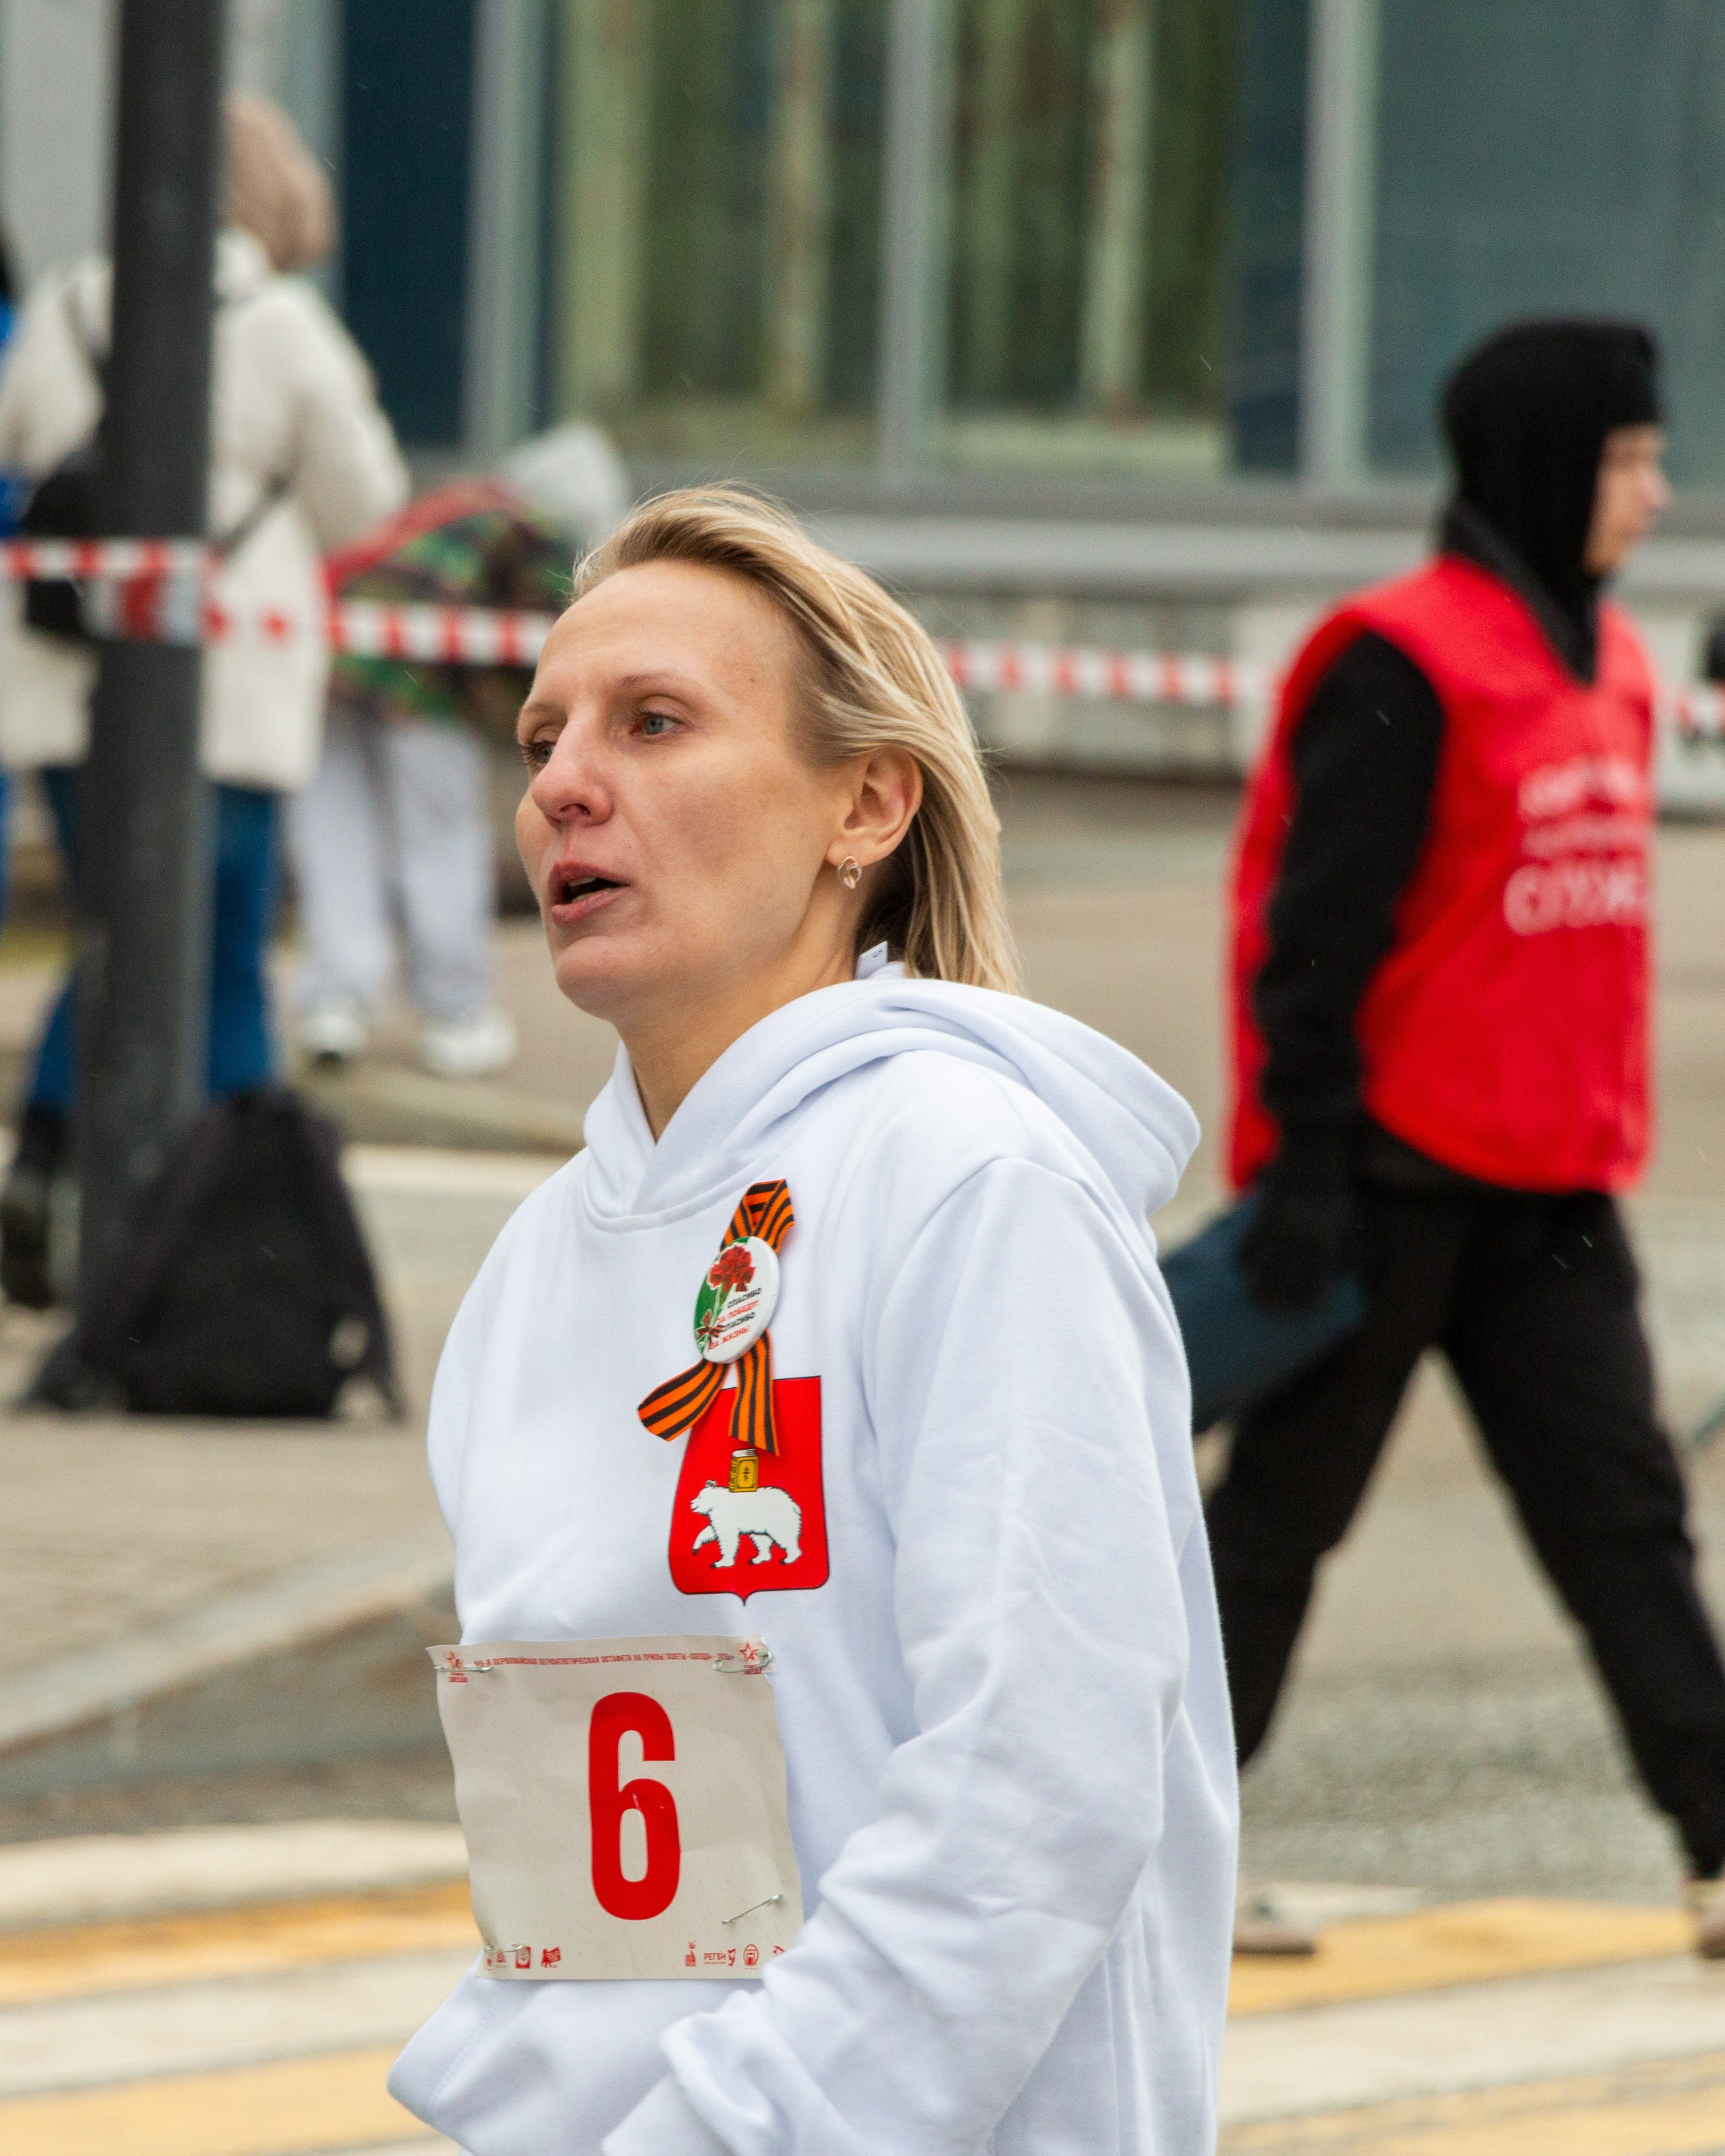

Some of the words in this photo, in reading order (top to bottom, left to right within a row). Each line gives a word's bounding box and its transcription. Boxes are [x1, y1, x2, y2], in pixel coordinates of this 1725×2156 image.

[727, 1288, 762, 1308] СПАСИБО
[589, 1691, 681, 1921] 6
[703, 1952, 726, 1961] РЕГБИ
